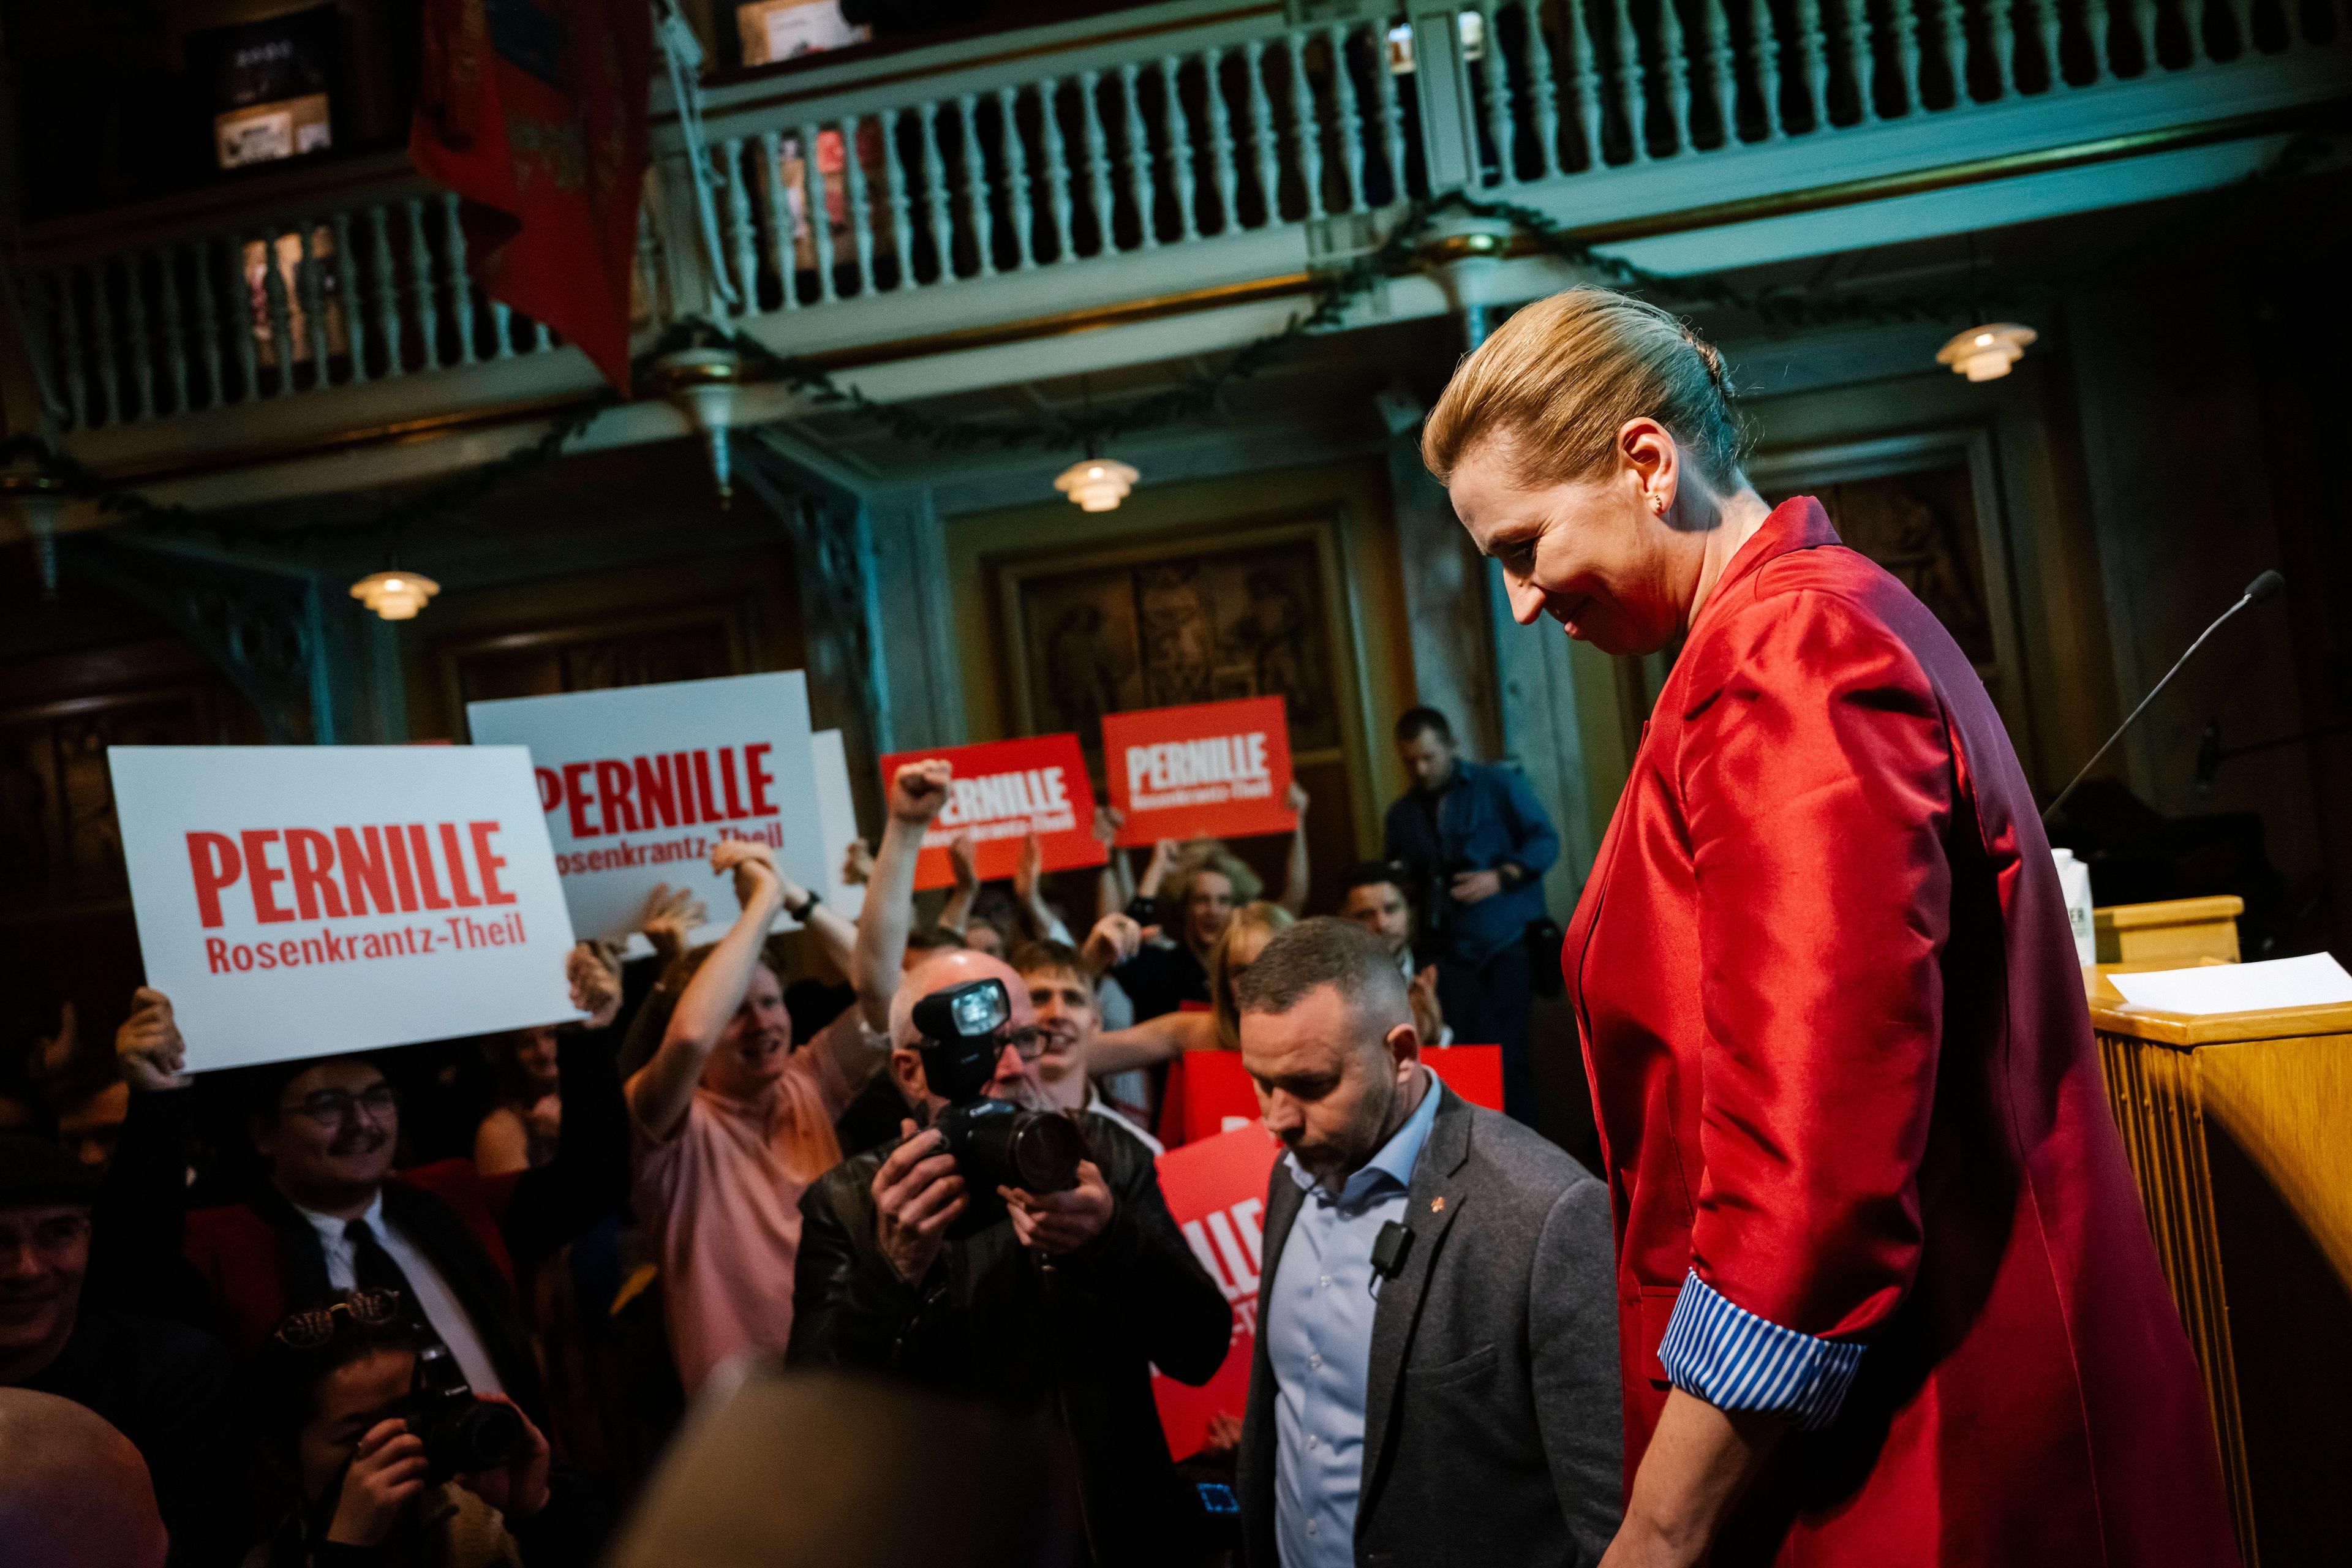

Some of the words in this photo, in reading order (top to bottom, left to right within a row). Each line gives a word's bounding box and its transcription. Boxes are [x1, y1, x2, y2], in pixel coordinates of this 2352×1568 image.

[1126, 732, 1269, 790] PERNILLE
[940, 766, 1071, 825] ERNILLE
[186, 821, 517, 929] PERNILLE
[205, 913, 526, 974] Rosenkrantz-Theil
